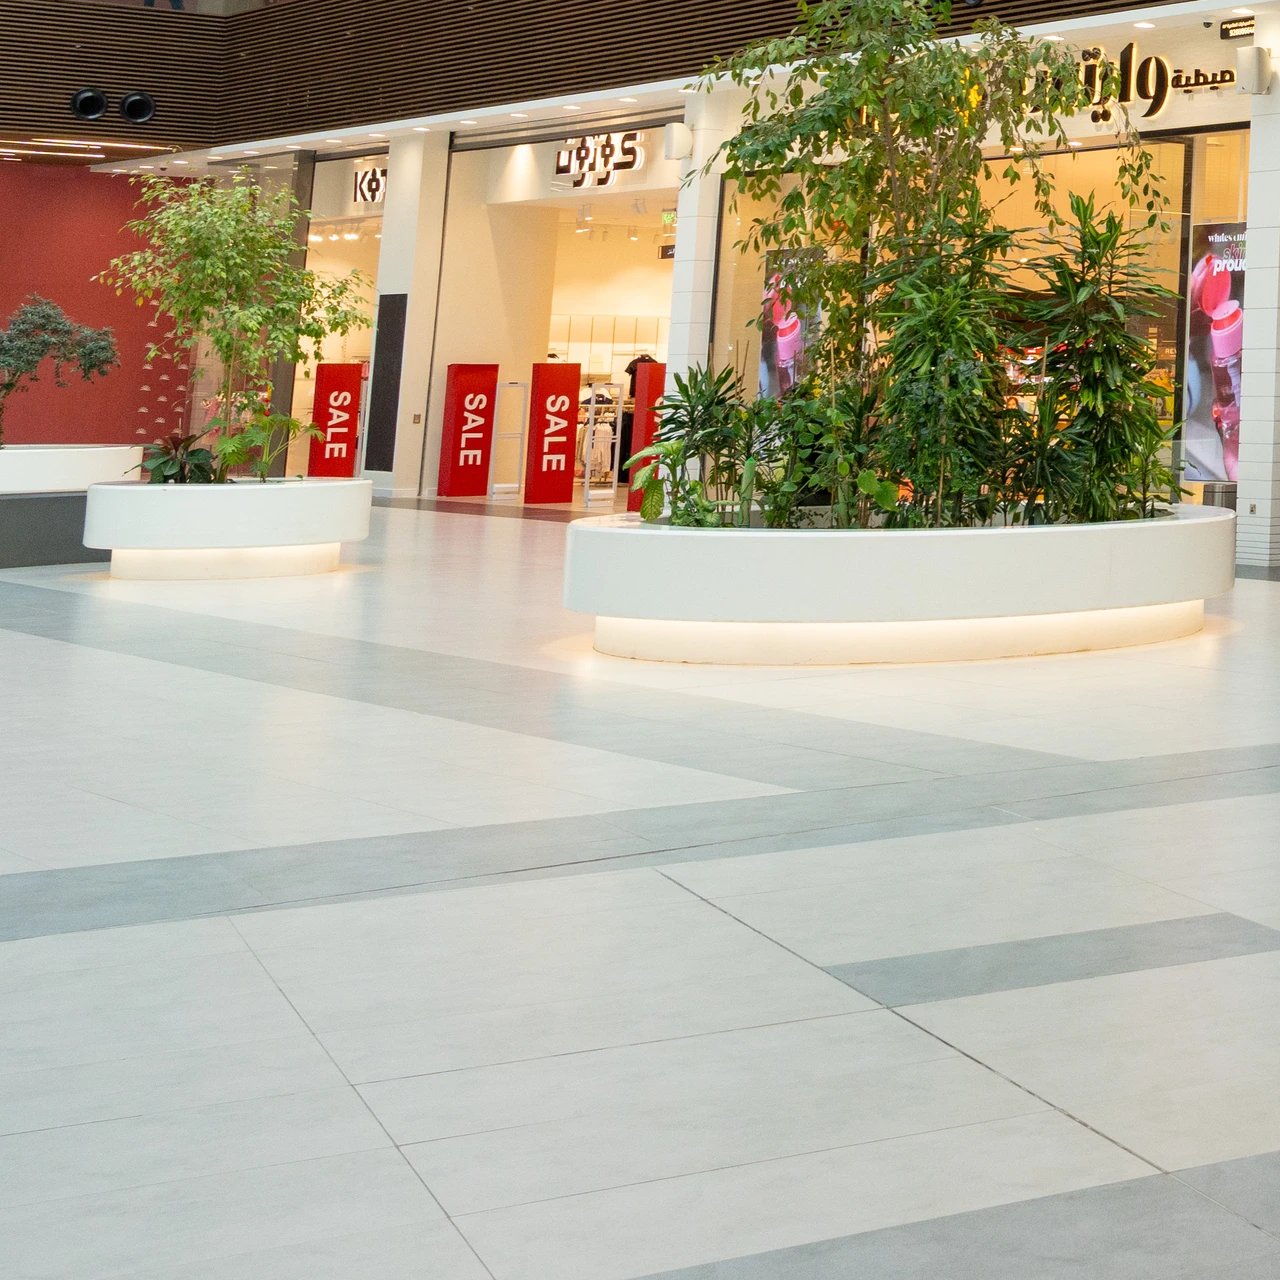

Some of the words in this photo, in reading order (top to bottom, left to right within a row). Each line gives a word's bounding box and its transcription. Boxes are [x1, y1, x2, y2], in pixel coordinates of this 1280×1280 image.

[325, 390, 351, 459] SALE
[459, 393, 487, 467] SALE
[542, 394, 570, 472] SALE
